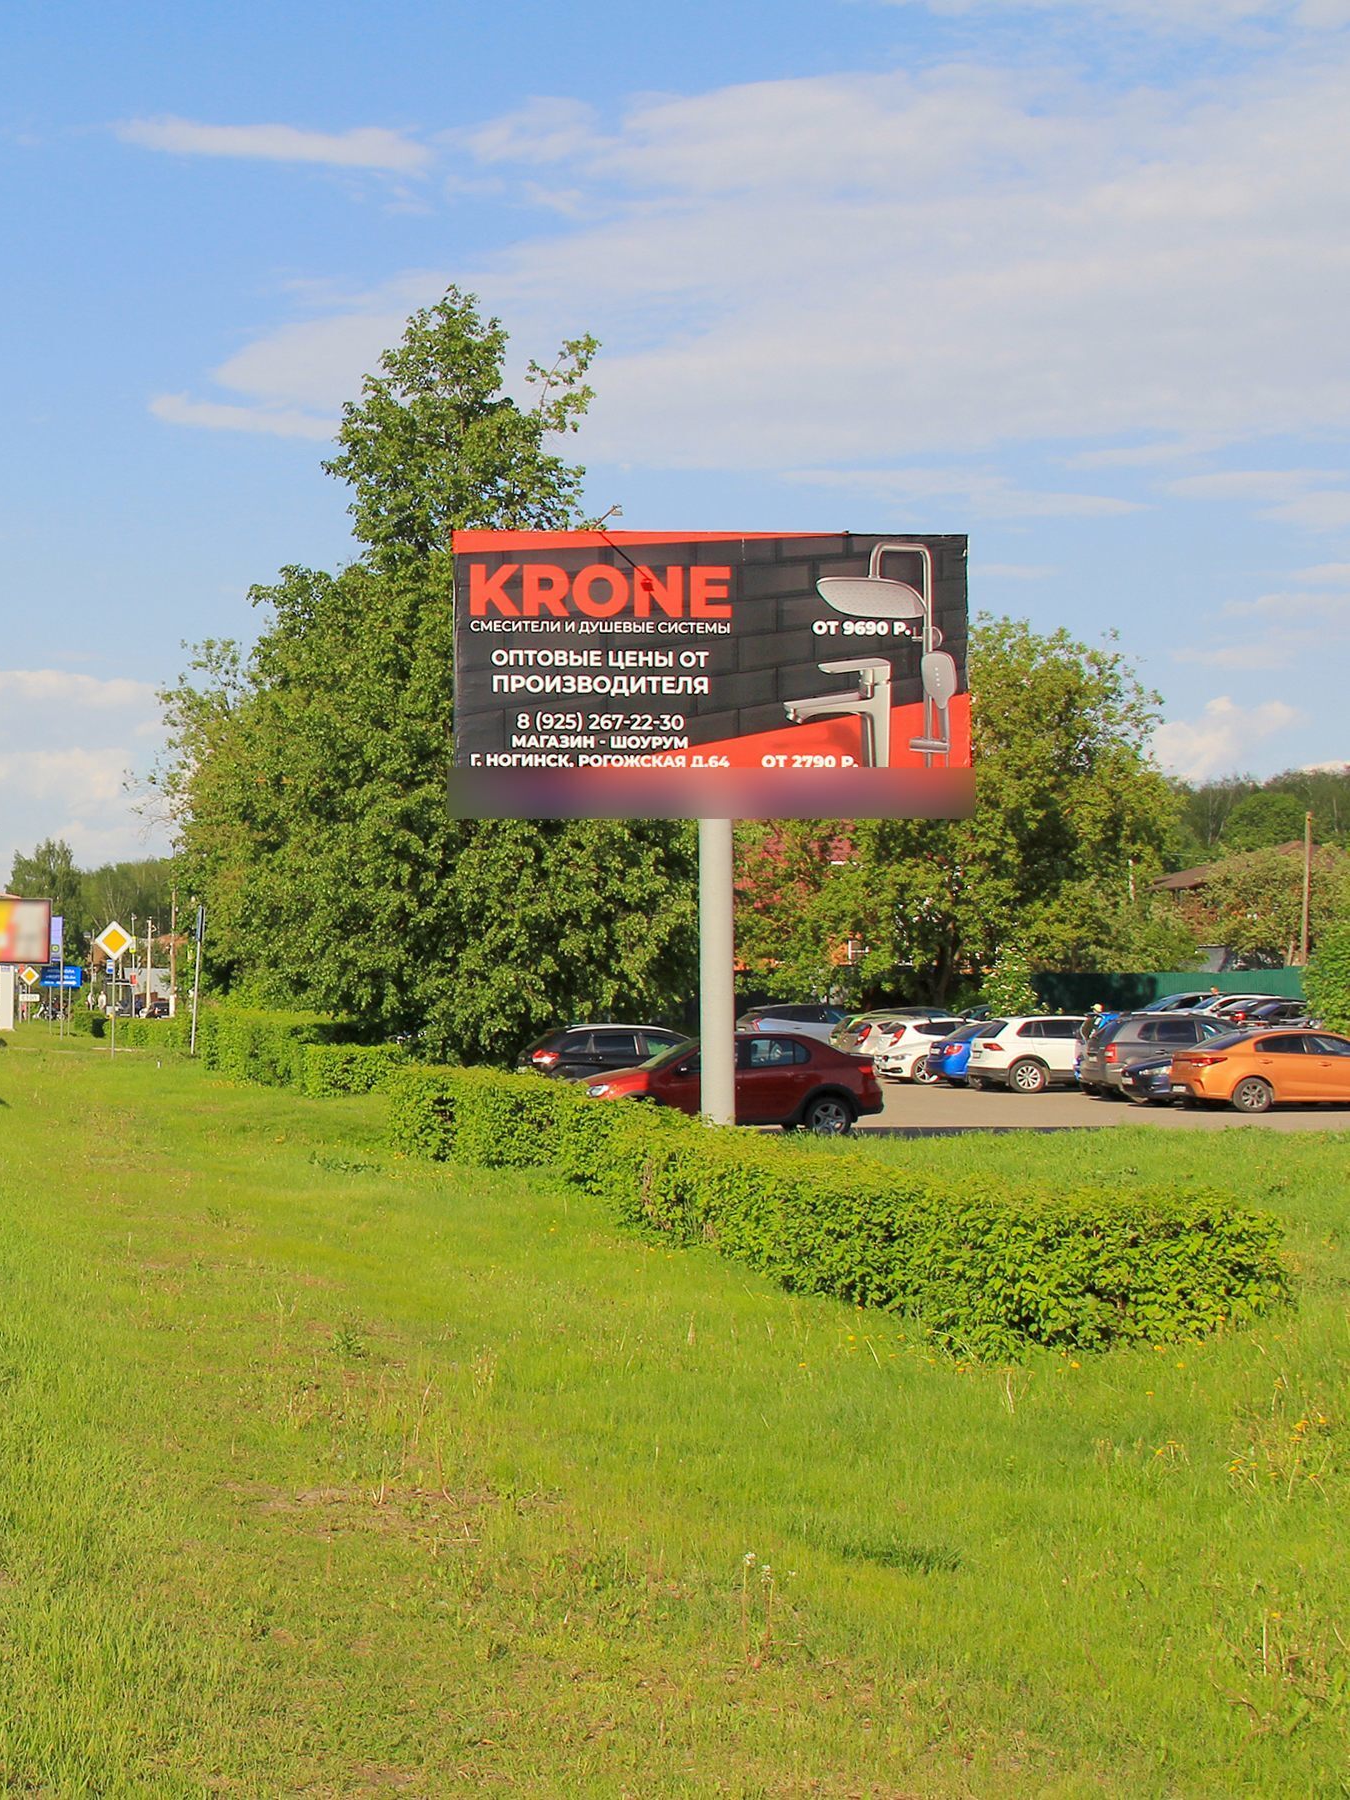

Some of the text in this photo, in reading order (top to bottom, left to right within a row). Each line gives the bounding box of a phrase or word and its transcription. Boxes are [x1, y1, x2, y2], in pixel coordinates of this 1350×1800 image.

[469, 563, 732, 618] KRONE
[470, 620, 731, 635] СМЕСИТЕЛИ И ДУШЕВЫЕ СИСТЕМЫ
[812, 621, 911, 636] ОТ 9690 Р.
[491, 649, 710, 669] ОПТОВЫЕ ЦЕНЫ ОТ
[492, 675, 710, 697] ПРОИЗВОДИТЕЛЯ
[516, 711, 685, 732] 8 (925) 267-22-30
[511, 735, 595, 749] МАГАЗИН
[610, 735, 689, 750] ШОУРУМ
[470, 754, 483, 767] Г.
[578, 754, 687, 768] РОГОЖСКАЯ
[691, 755, 730, 768] Д.64
[761, 755, 790, 768] ОТ
[791, 755, 836, 768] 2790
